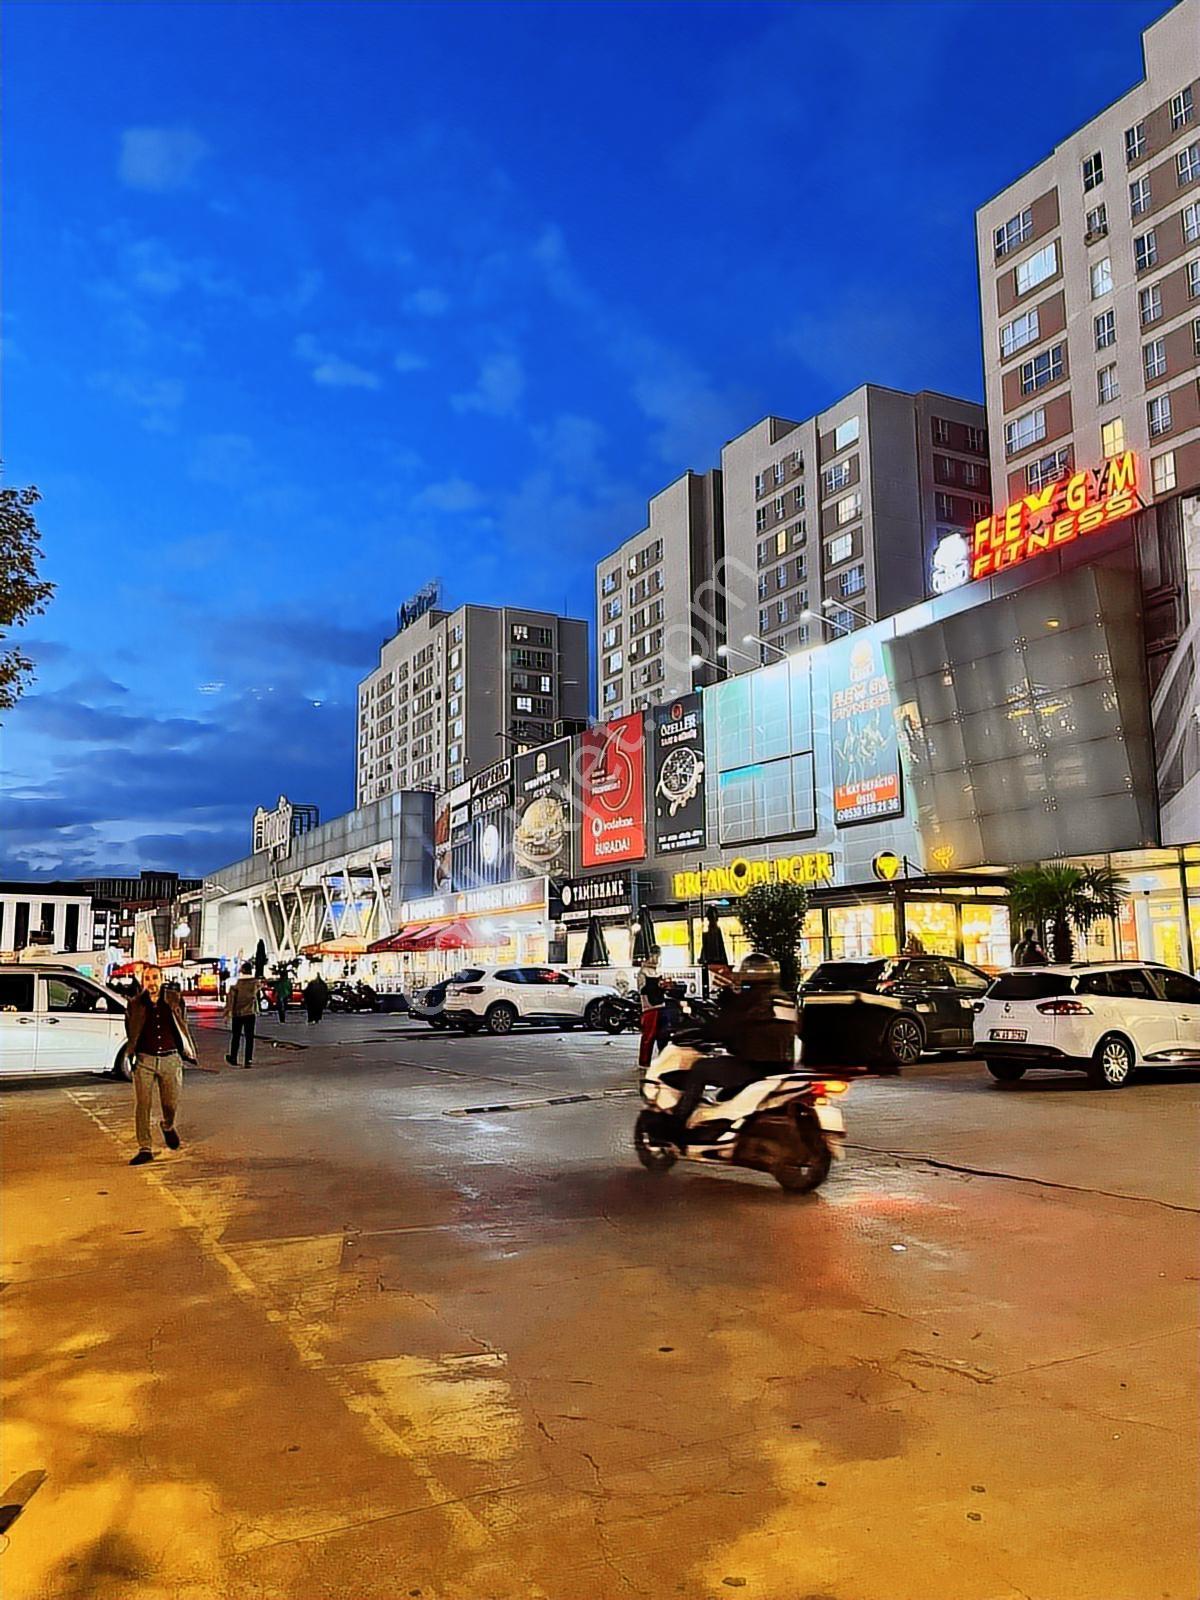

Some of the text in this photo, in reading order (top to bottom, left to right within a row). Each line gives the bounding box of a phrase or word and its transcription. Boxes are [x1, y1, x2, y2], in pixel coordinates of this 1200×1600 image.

[973, 451, 1136, 555] FLEX GYM
[972, 490, 1134, 578] FITNESS
[595, 838, 630, 855] BURADA!
[603, 816, 634, 831] vodafone
[672, 852, 834, 900] ERCAN BURGER
